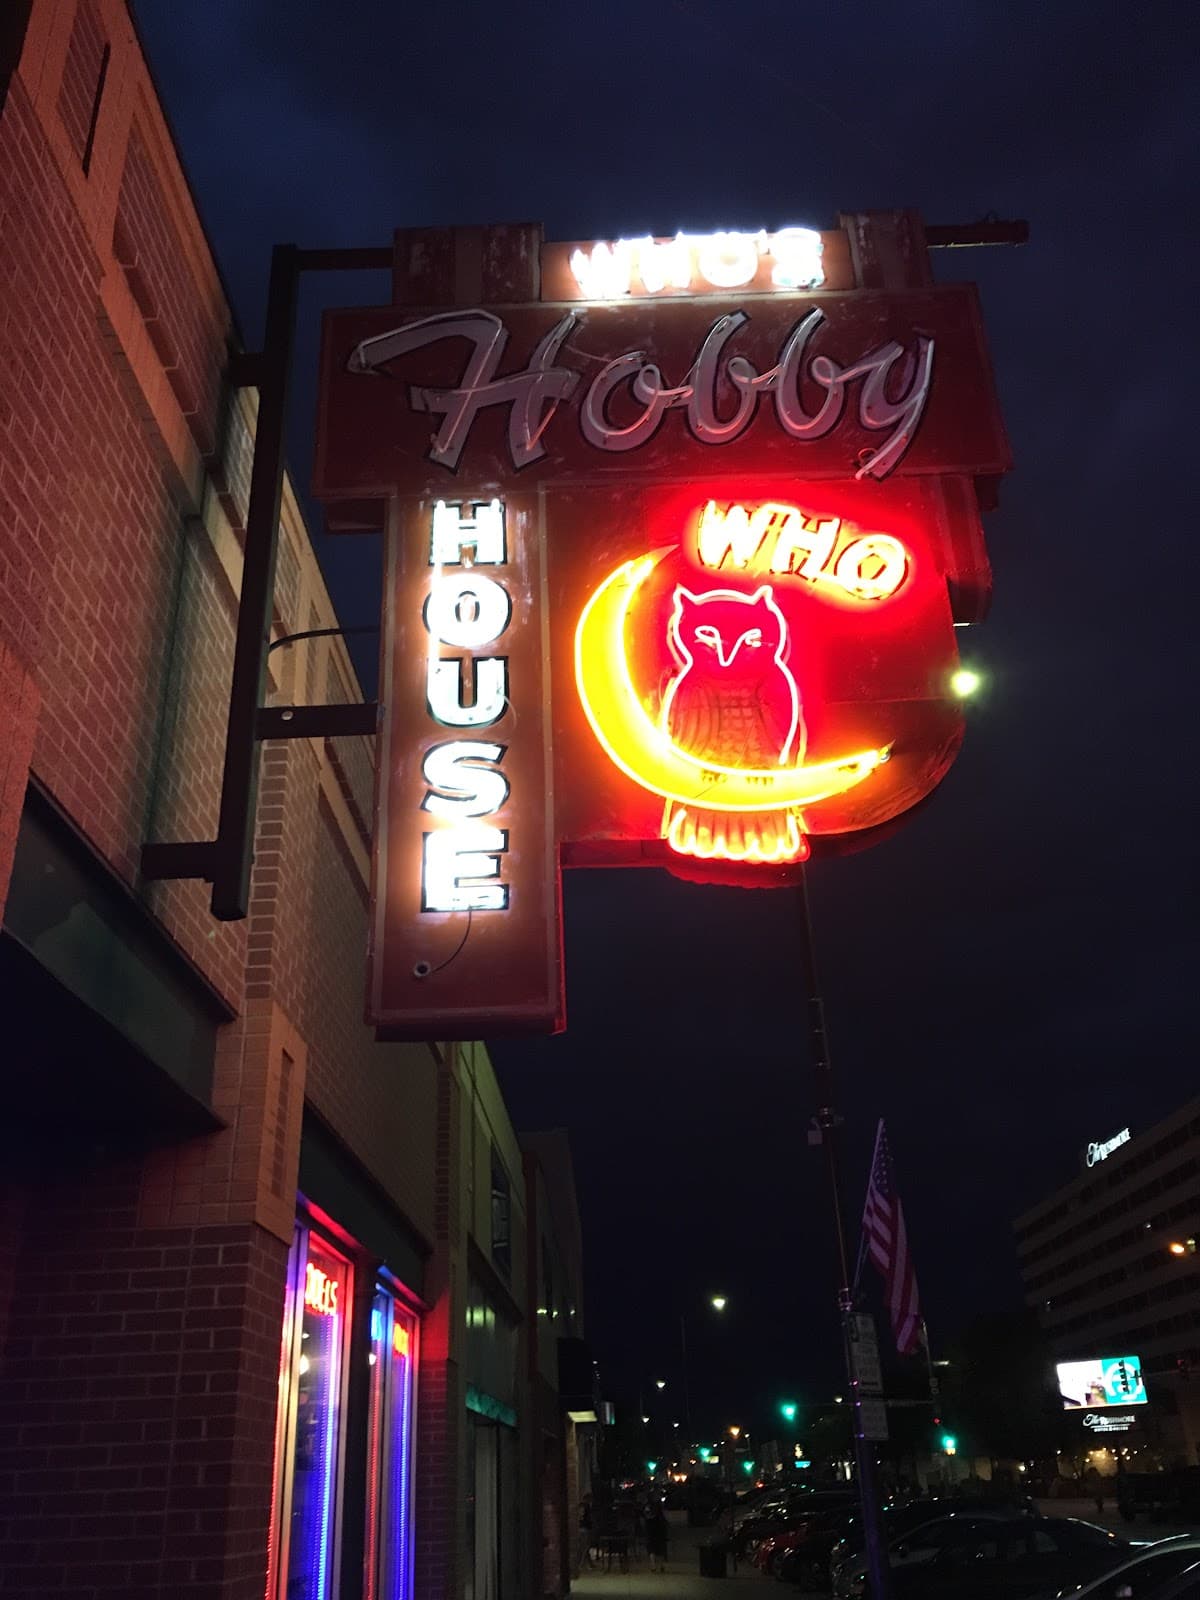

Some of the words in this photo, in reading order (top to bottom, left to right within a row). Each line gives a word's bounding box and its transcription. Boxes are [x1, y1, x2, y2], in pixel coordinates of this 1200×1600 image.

[347, 306, 935, 480] Hobby
[697, 500, 911, 600] WHO
[420, 498, 512, 913] HOUSE
